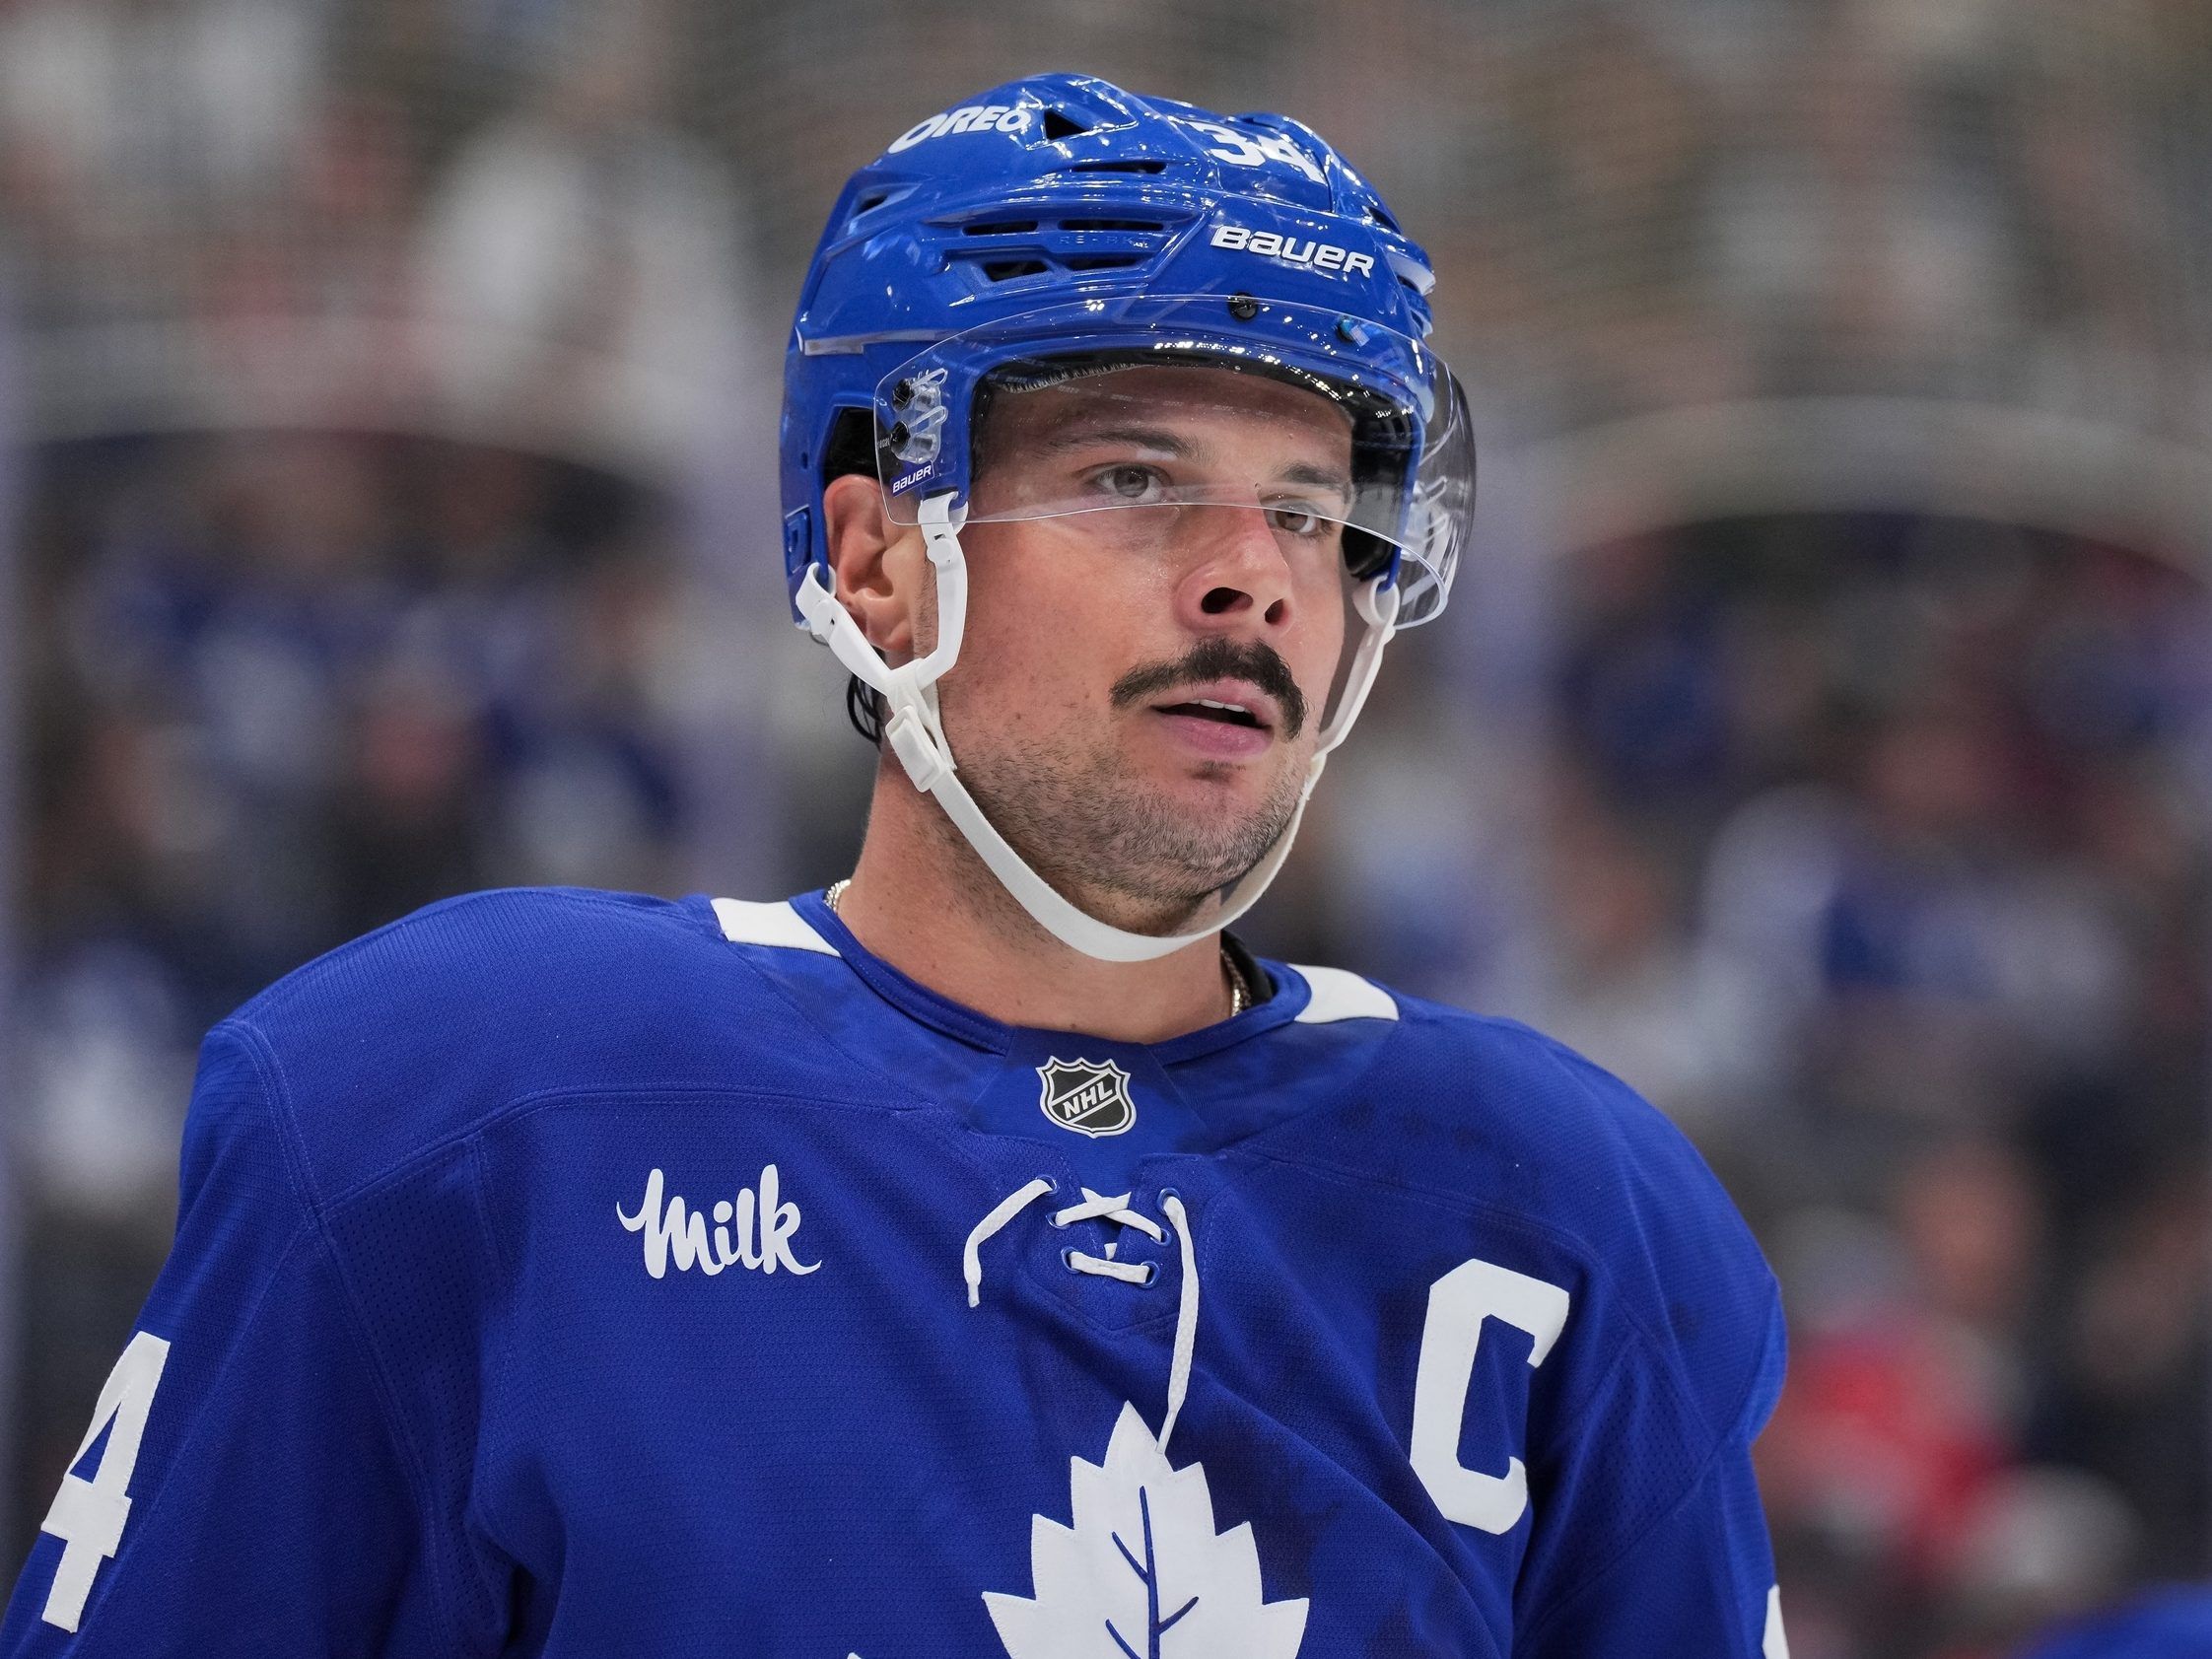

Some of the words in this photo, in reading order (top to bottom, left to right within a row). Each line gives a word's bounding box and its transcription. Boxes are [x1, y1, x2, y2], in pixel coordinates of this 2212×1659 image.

[888, 105, 1031, 154] OREO
[1186, 121, 1329, 187] 34
[1210, 226, 1374, 278] BAUER
[892, 464, 932, 494] BAUER
[1063, 1080, 1113, 1119] NHL
[616, 1164, 822, 1279] Milk
[1410, 1258, 1570, 1536] C
[40, 1331, 171, 1633] 4
